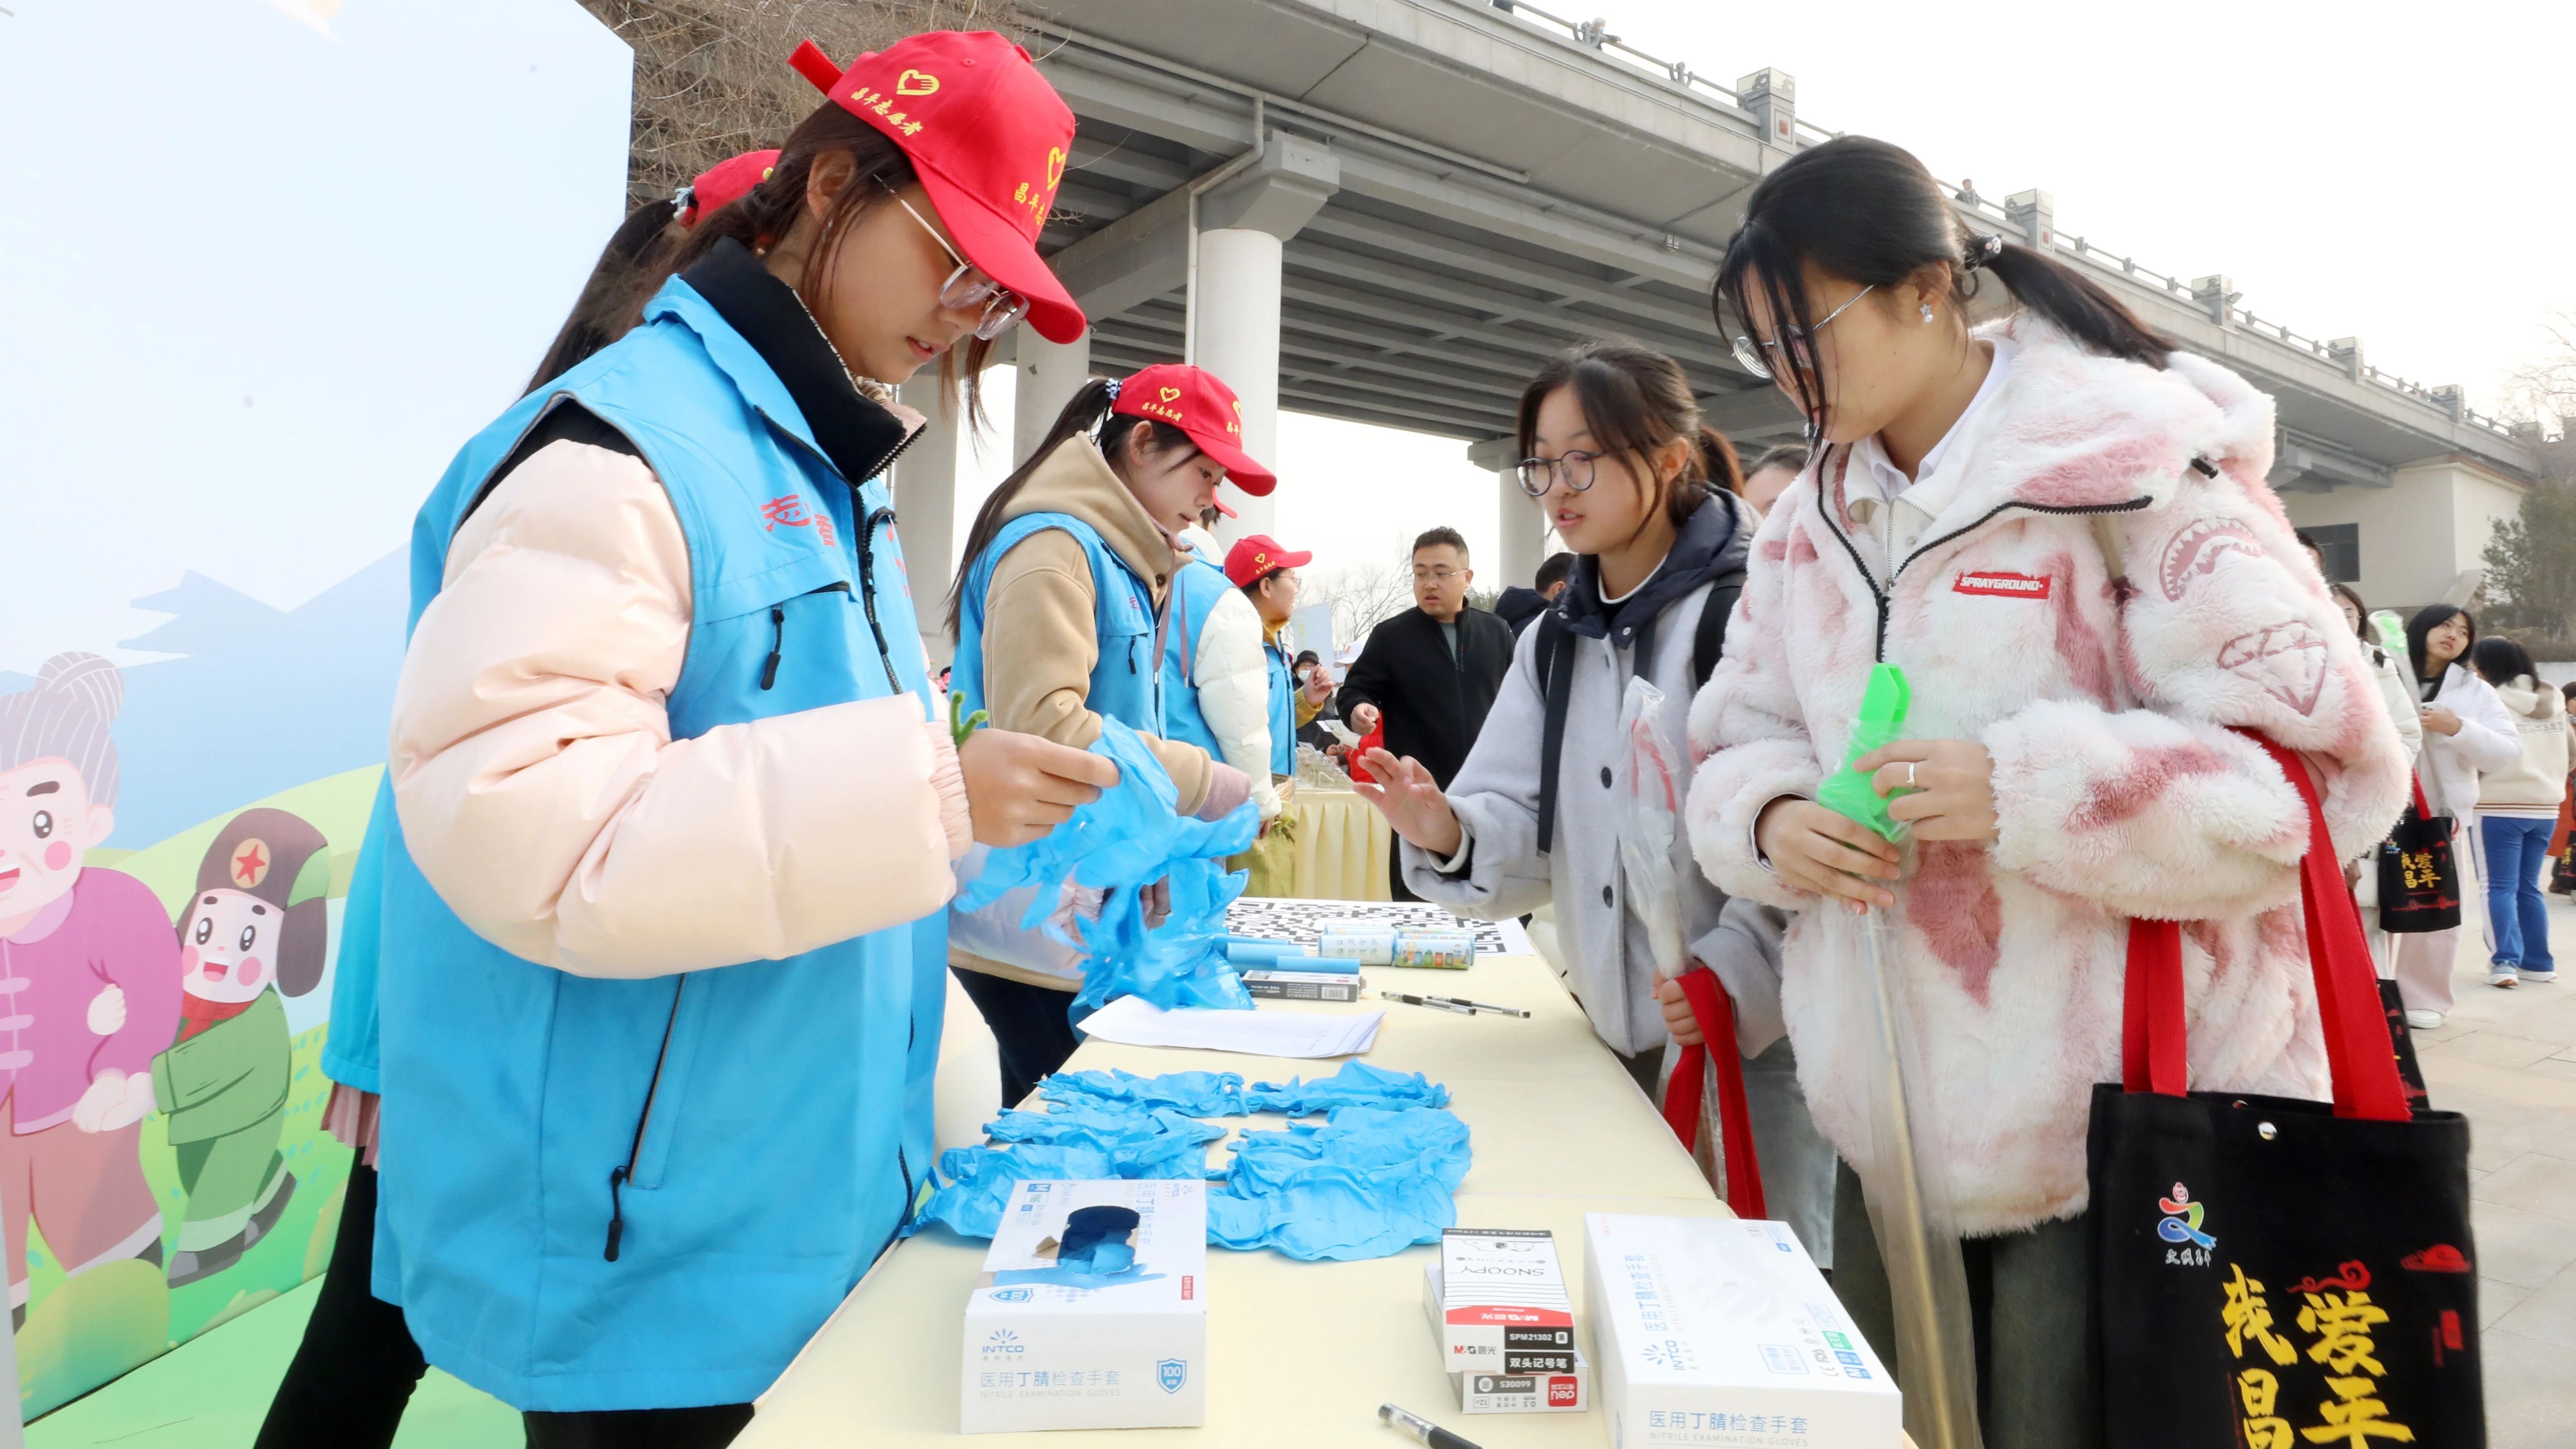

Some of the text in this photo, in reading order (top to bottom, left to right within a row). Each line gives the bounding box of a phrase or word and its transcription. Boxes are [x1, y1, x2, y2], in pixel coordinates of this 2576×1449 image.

[851, 87, 923, 136] 昌平志愿者
[761, 494, 835, 547] 志者
[1460, 1266, 1545, 1276] SNOOPY
[2222, 1263, 2390, 1376] 我爱
[1509, 1357, 1568, 1368] 双头记号笔
[1665, 1340, 1685, 1370] INTCO
[980, 1370, 1121, 1388] 医用丁腈检查手套
[1163, 1367, 1181, 1377] 100
[1020, 1389, 1081, 1398] EXAMINATION
[1086, 1389, 1121, 1397] GLOVES
[1550, 1391, 1575, 1400] deli
[1649, 1410, 1808, 1434] 医用丁腈检查手套
[1649, 1432, 1809, 1447] NITRILE EXAMINATION GLOVES
